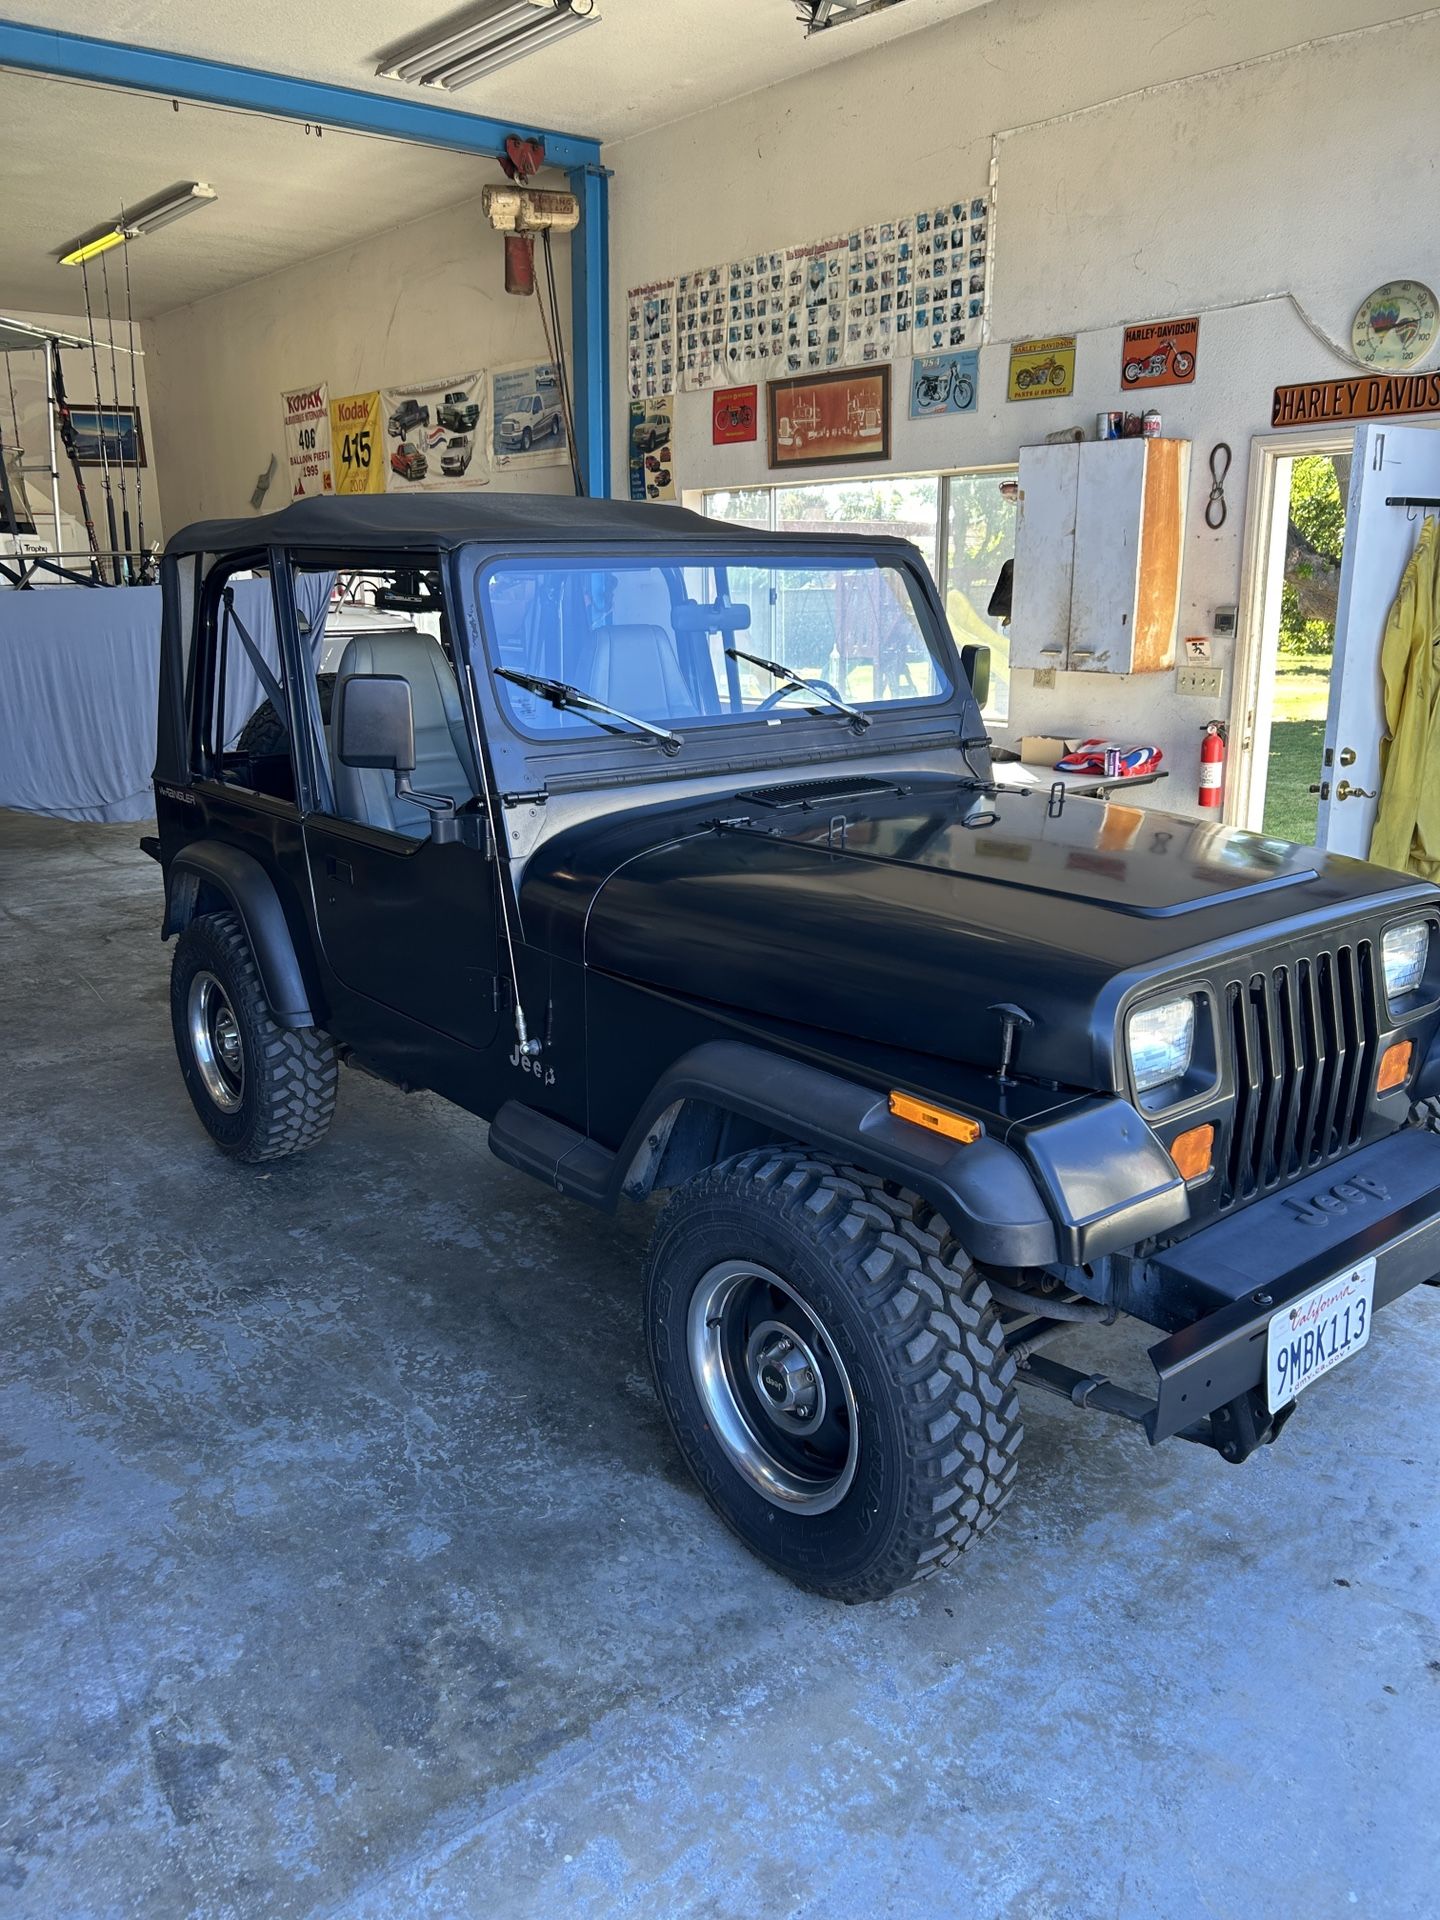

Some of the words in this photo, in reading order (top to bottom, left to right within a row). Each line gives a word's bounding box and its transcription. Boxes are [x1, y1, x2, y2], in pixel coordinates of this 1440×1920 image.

[1382, 288, 1391, 296] 20
[1424, 311, 1434, 319] 80
[1357, 321, 1366, 329] 20
[1418, 333, 1431, 341] 100
[1401, 352, 1414, 360] 120
[1040, 387, 1067, 395] SERVICE
[287, 388, 322, 414] KODAK
[1282, 383, 1361, 421] HARLEY
[338, 400, 369, 422] Kodak
[298, 428, 316, 450] 406
[290, 453, 313, 466] BALLOON
[342, 431, 371, 469] 415
[303, 465, 319, 478] 1995
[24, 544, 48, 554] Trophy
[509, 1044, 556, 1086] Jeep
[1281, 1174, 1391, 1227] Jeep
[1291, 1285, 1356, 1332] California
[1277, 1297, 1367, 1396] 9MBK113
[1294, 1350, 1346, 1391] dmv.ca.gov
[765, 1376, 784, 1392] Jeep
